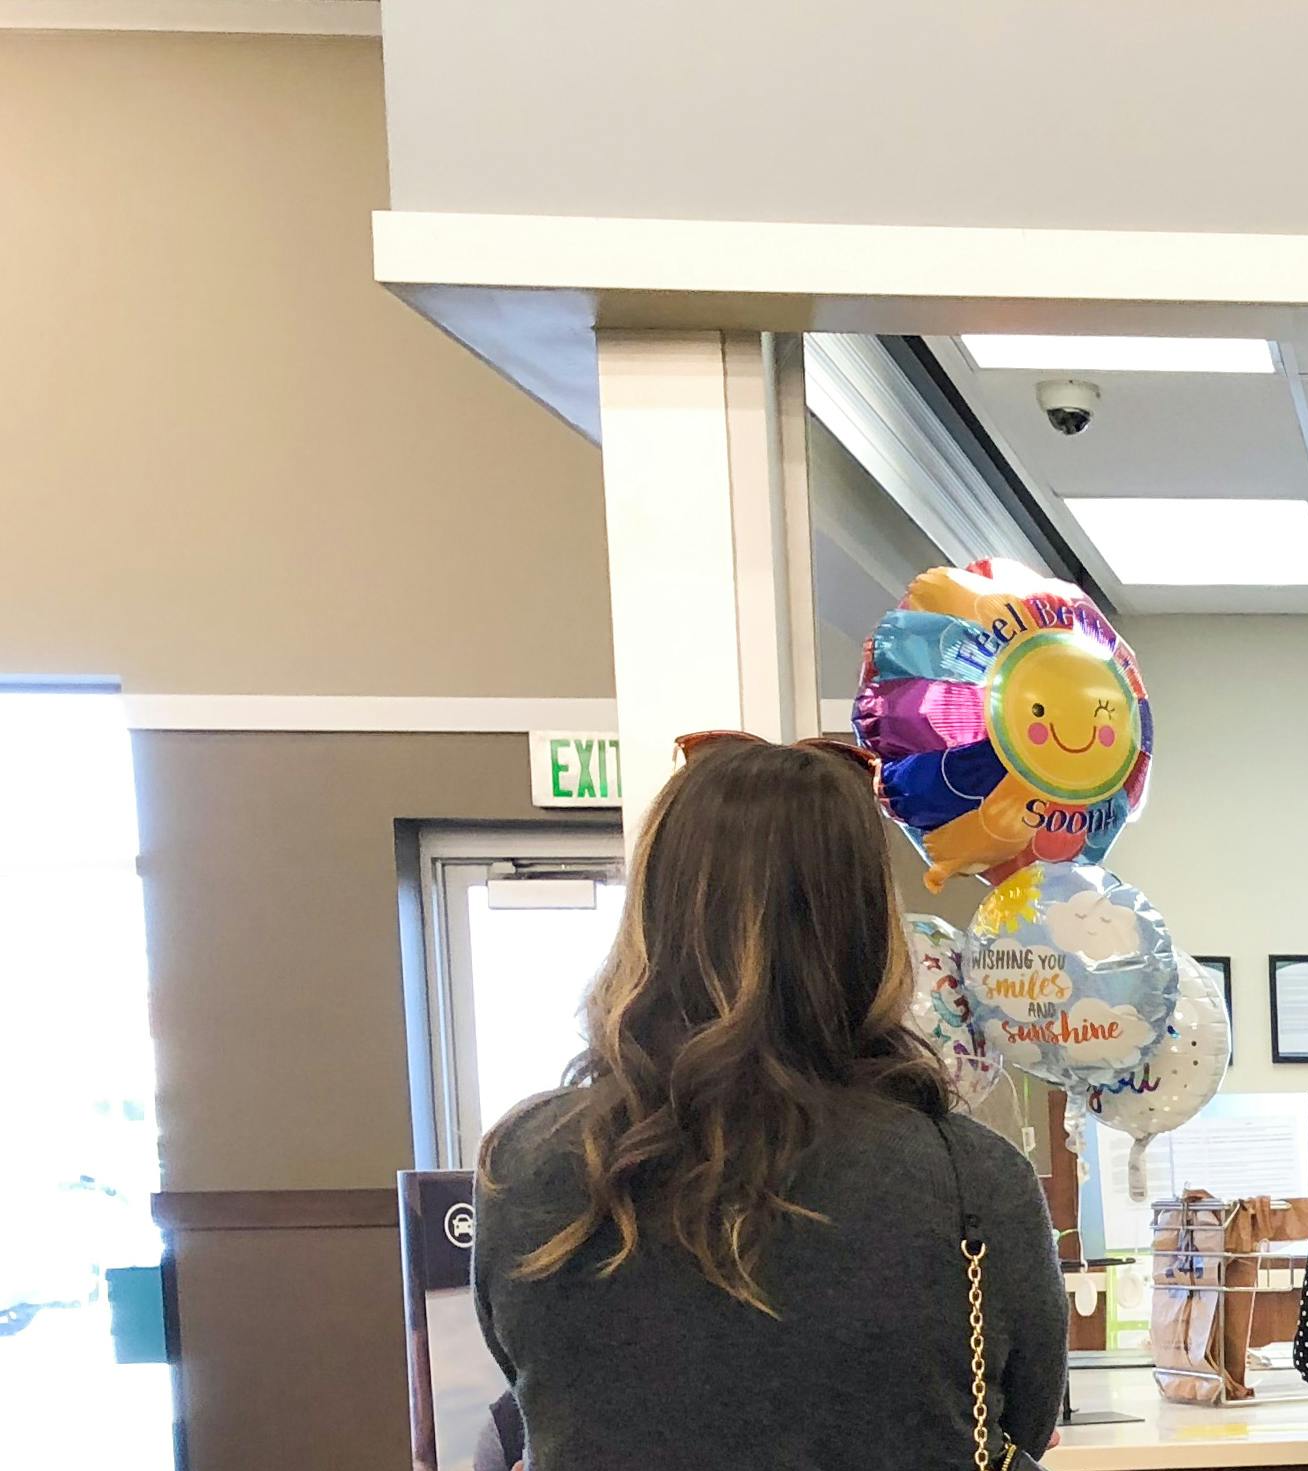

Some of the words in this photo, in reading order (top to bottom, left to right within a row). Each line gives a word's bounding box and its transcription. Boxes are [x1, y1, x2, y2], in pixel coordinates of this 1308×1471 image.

[1021, 798, 1118, 834] Soon!
[971, 949, 1034, 970] WISHING
[1038, 953, 1066, 970] YOU
[982, 971, 1070, 1000] smiles
[1028, 1002, 1057, 1018] AND
[1001, 1010, 1122, 1044] sunshine
